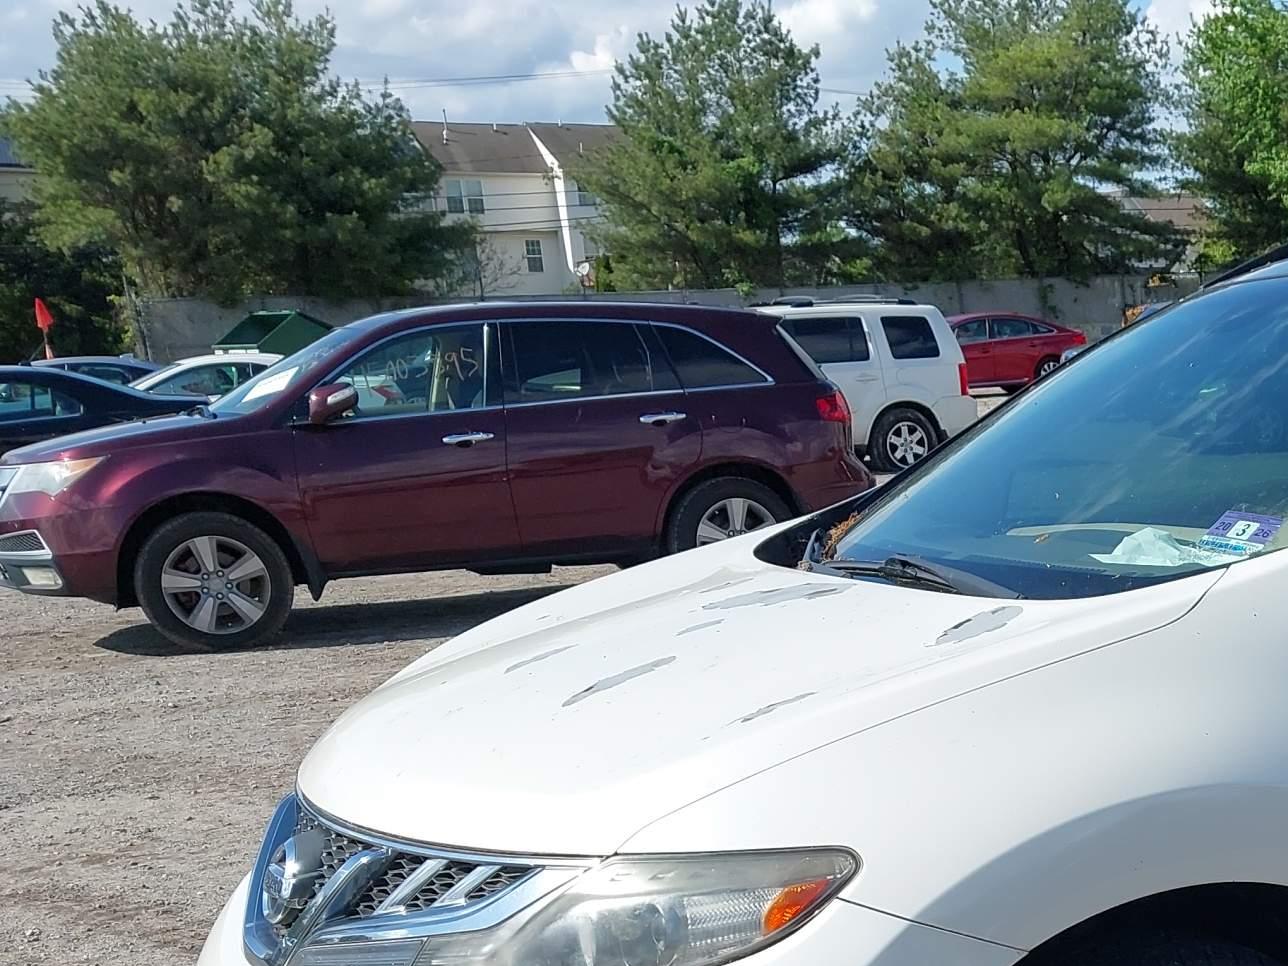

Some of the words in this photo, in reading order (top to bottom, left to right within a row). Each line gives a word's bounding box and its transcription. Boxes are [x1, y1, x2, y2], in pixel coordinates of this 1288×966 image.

[1215, 520, 1232, 531] 20
[1236, 523, 1251, 537] 3
[1254, 528, 1273, 538] 26
